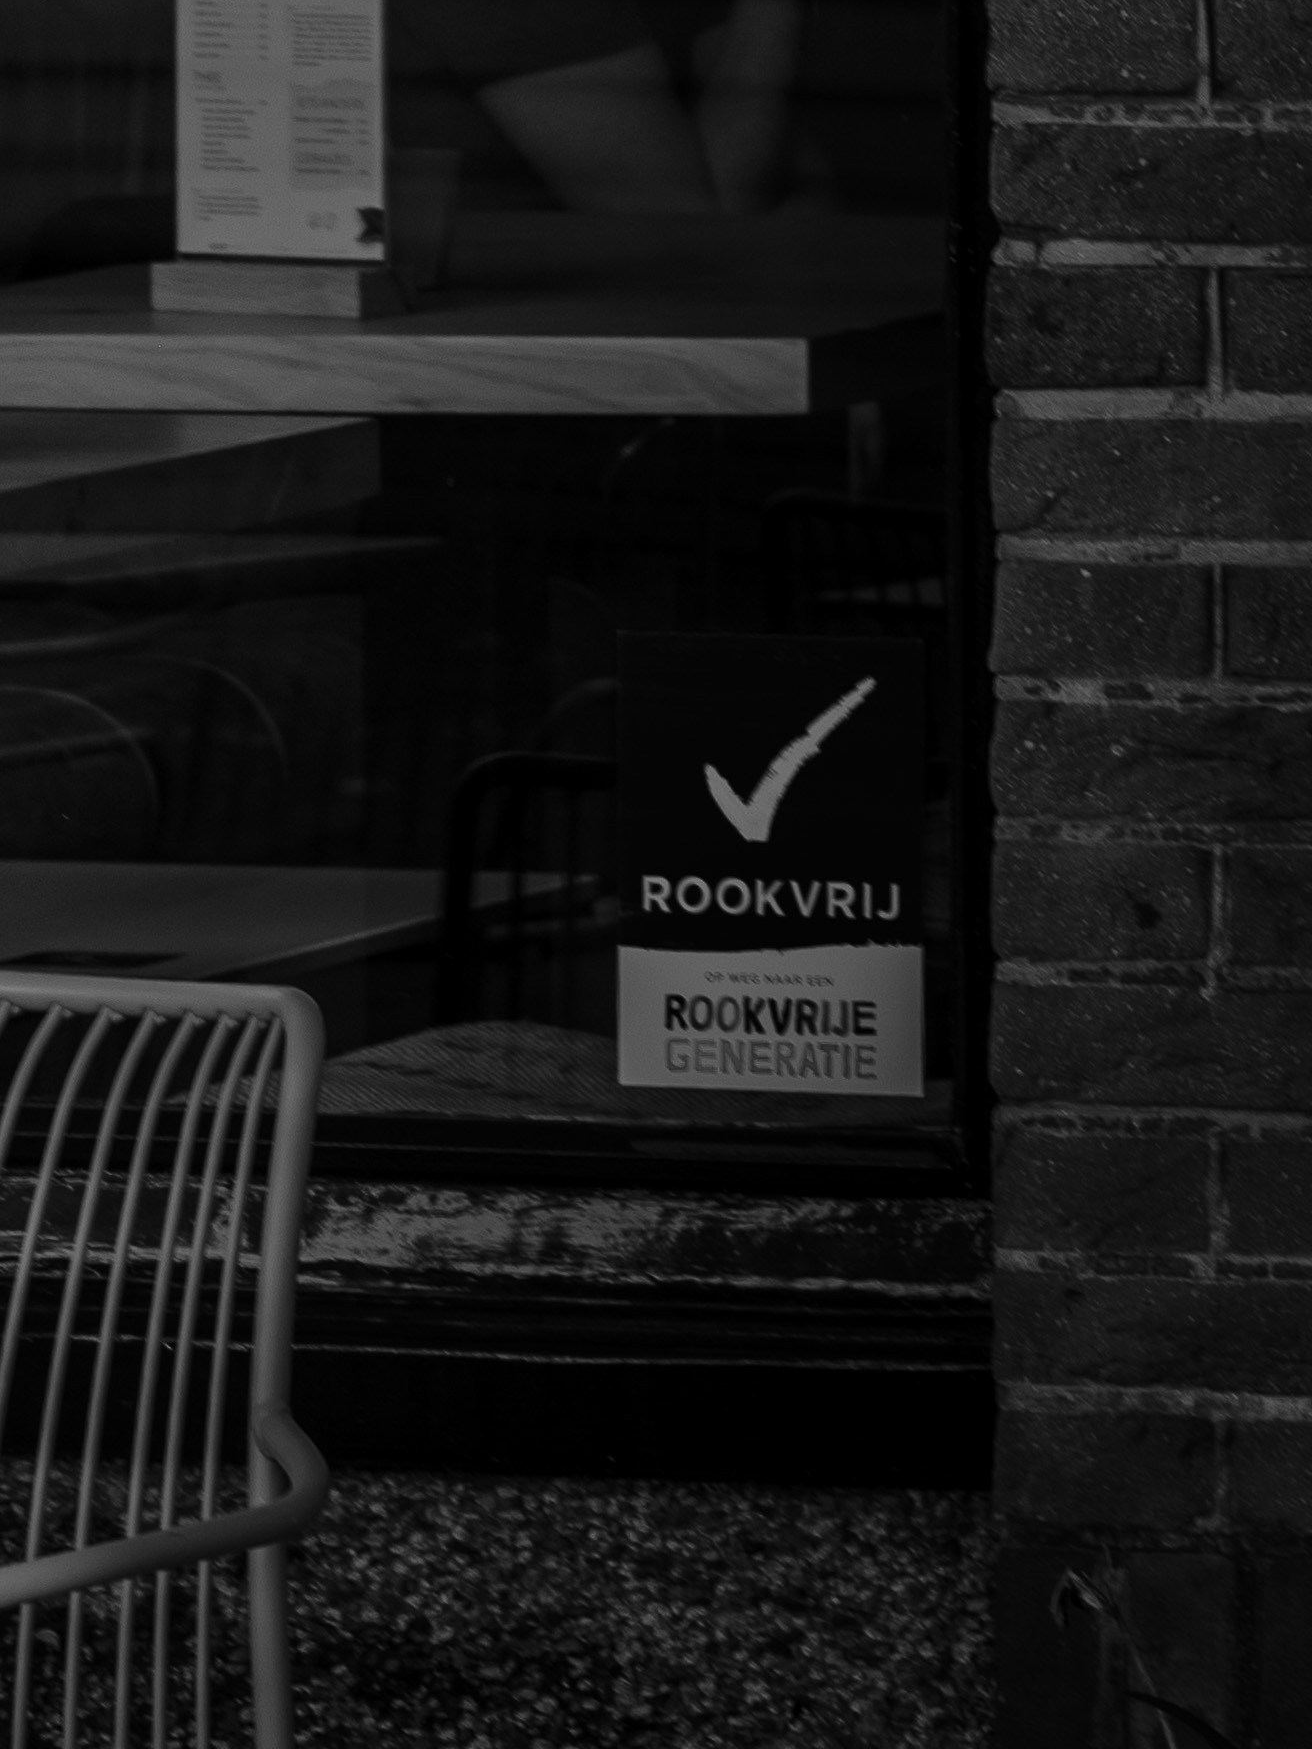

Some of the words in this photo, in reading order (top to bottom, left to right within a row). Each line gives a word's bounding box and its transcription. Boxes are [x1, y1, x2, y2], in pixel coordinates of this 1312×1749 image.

[641, 874, 901, 921] ROOKVRIJ
[763, 973, 803, 987] NAAR
[664, 992, 878, 1036] ROOKVRIJE
[664, 1038, 878, 1080] GENERATIE
